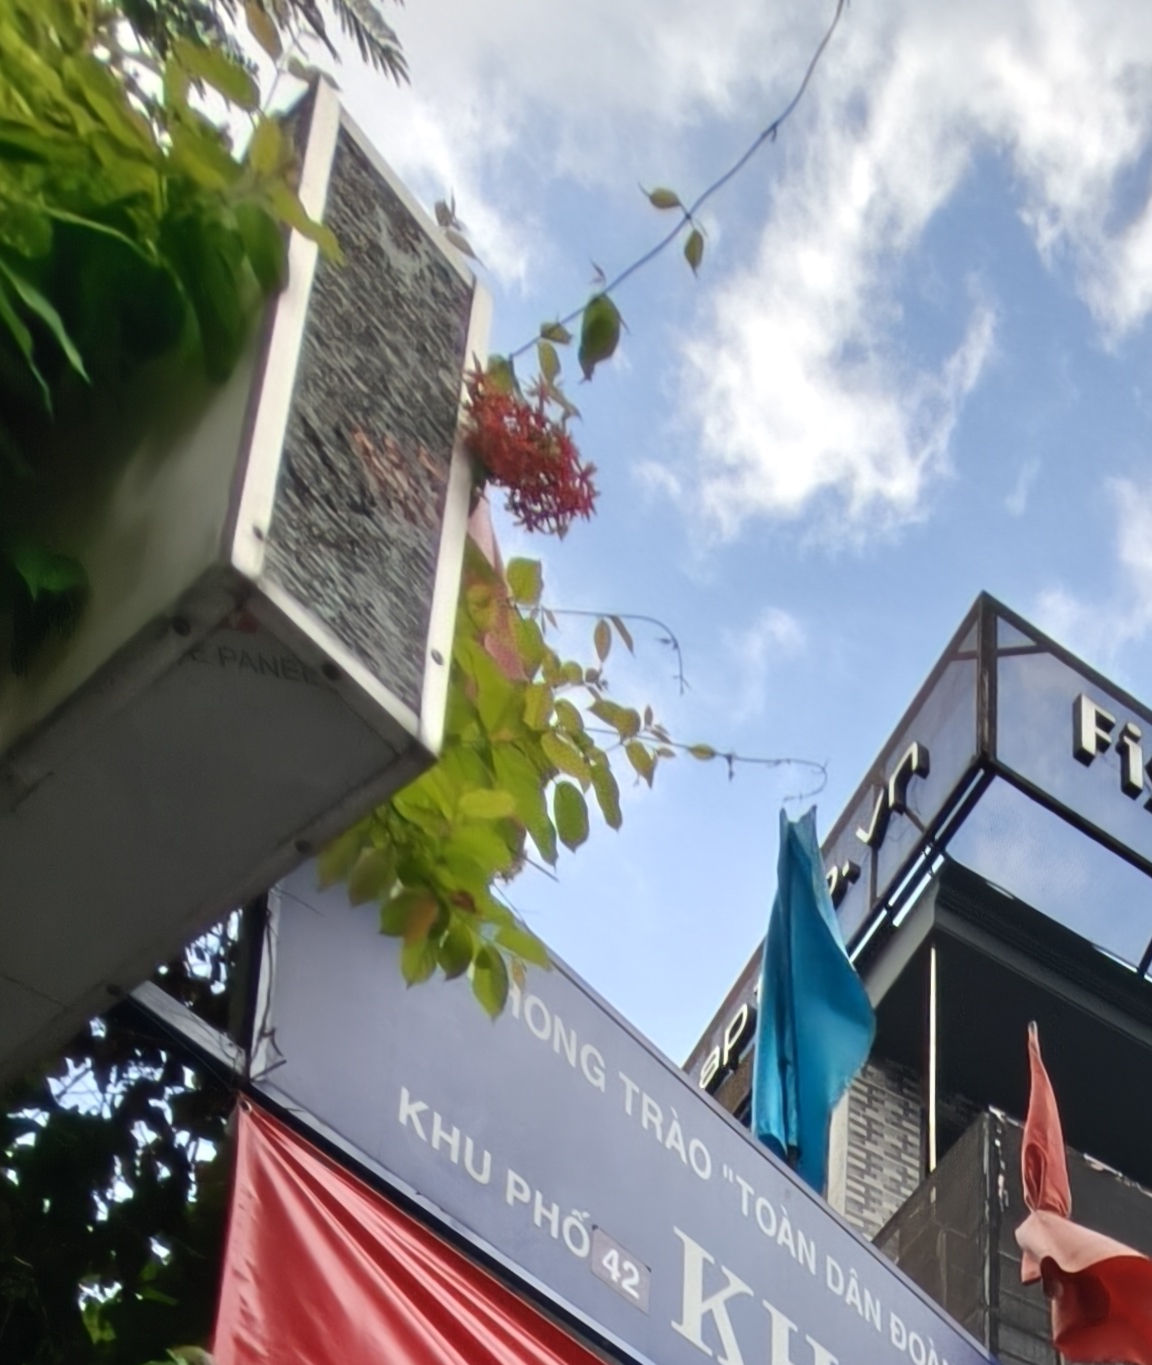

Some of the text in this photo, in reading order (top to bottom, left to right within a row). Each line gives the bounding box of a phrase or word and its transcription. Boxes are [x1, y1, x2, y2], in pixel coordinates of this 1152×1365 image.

[399, 1087, 640, 1300] KHU PHỐ 42
[619, 1070, 712, 1180] TRÀO
[723, 1163, 817, 1276] "TOÀN
[827, 1254, 882, 1331] DÂN
